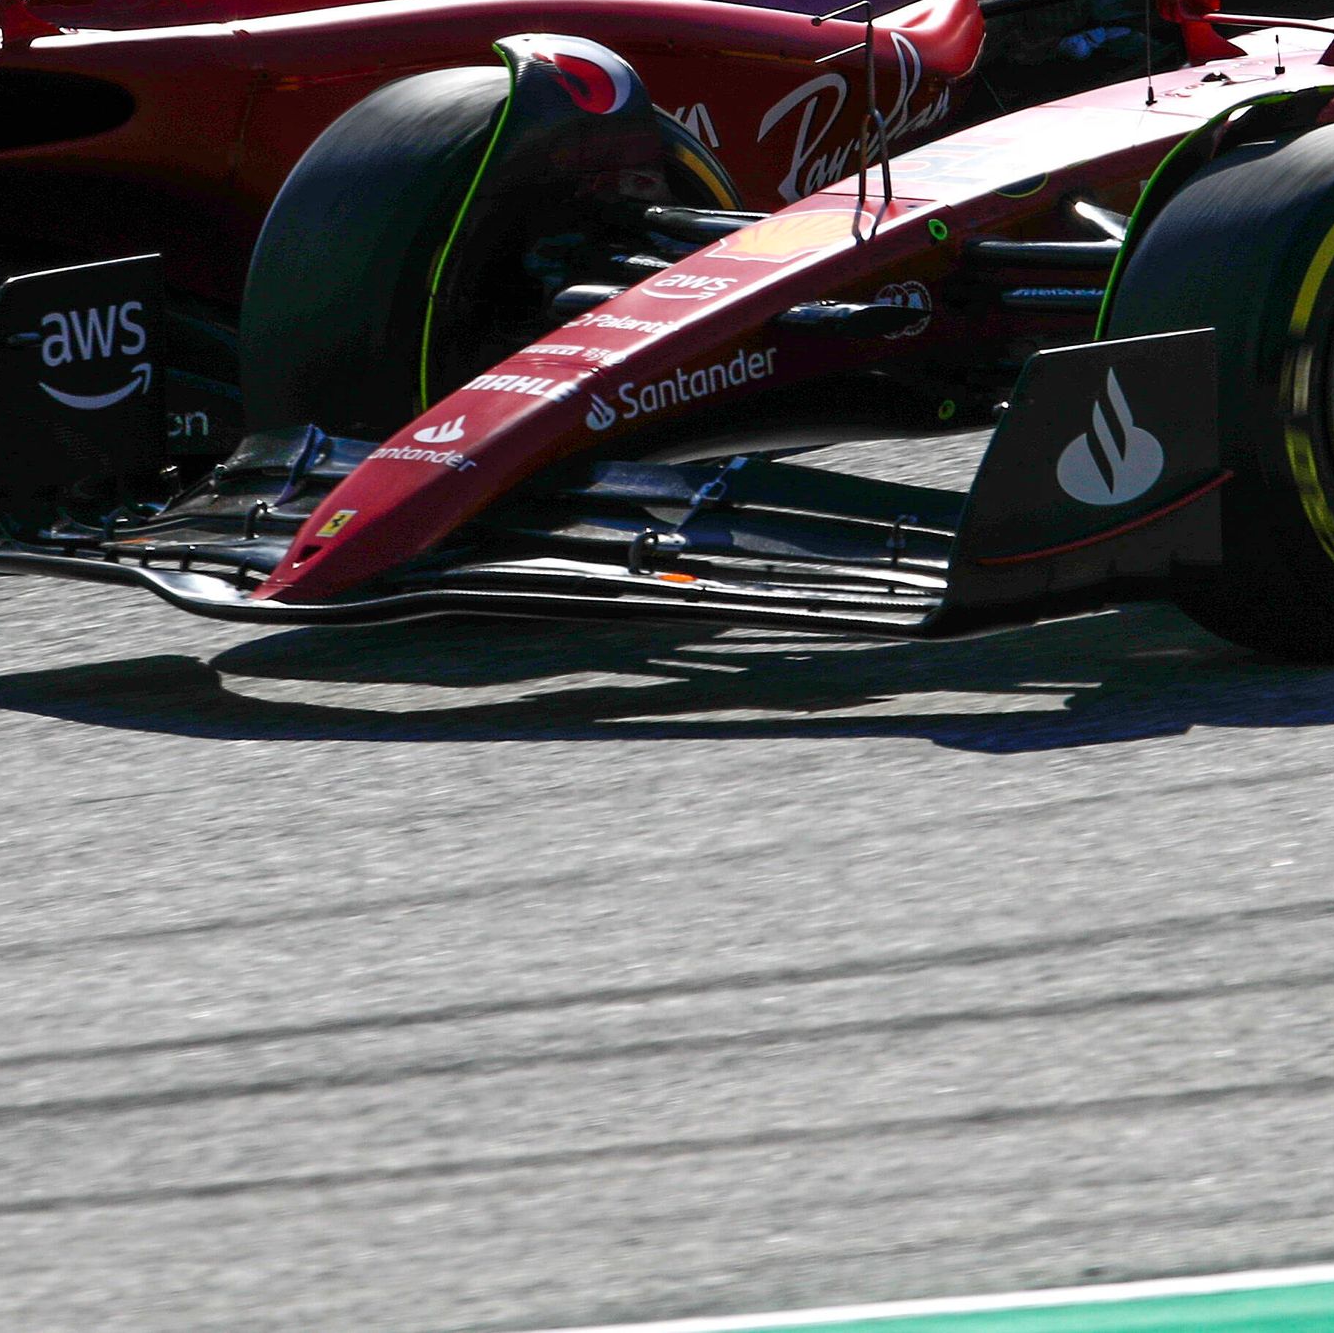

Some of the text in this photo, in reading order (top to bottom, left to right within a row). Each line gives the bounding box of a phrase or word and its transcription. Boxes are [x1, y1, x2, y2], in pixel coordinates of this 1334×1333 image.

[654, 274, 739, 292] aws
[40, 300, 148, 367] aws
[461, 374, 581, 403] MAHLE
[617, 343, 777, 422] Santander
[367, 448, 476, 472] antander
